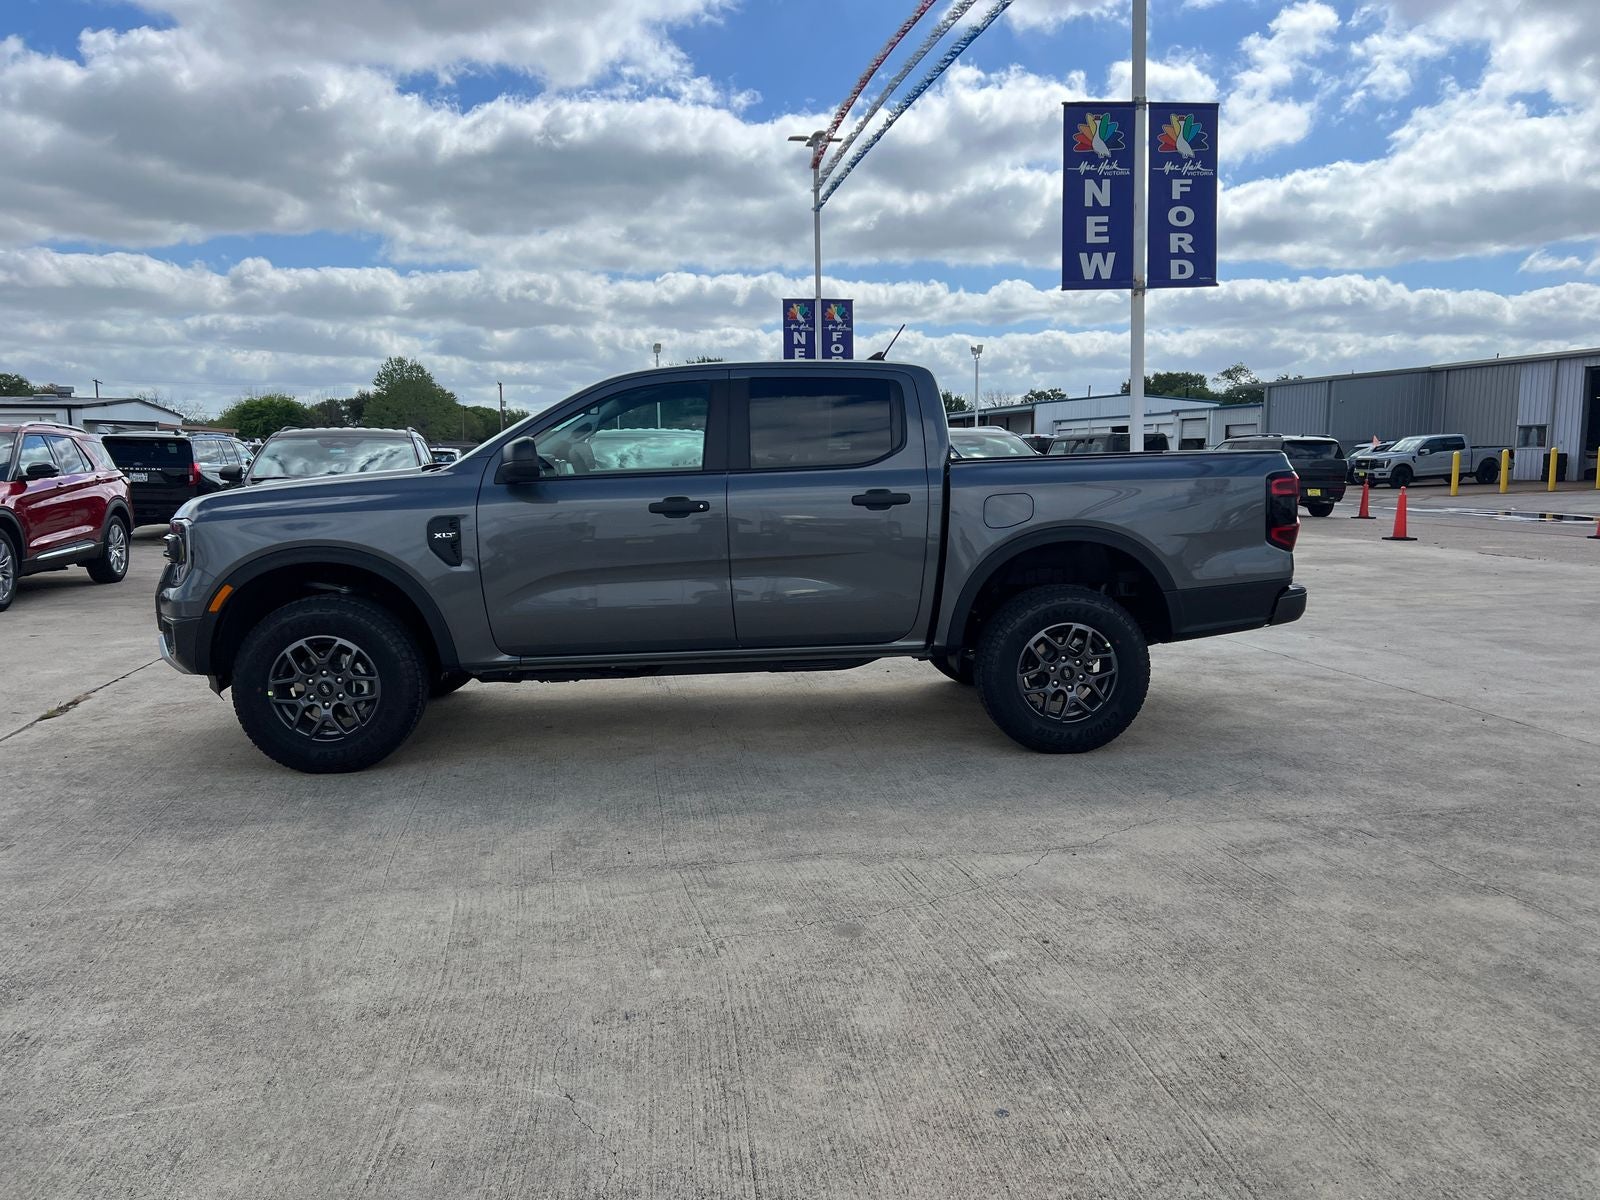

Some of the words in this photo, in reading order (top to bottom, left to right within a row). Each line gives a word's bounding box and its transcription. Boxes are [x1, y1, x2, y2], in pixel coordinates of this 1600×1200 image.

[1074, 161, 1097, 175] Mac
[1098, 159, 1125, 175] Haik
[1159, 161, 1181, 175] Mac
[1182, 160, 1209, 175] Haik
[1079, 179, 1116, 280] NEW
[1167, 179, 1195, 280] FORD
